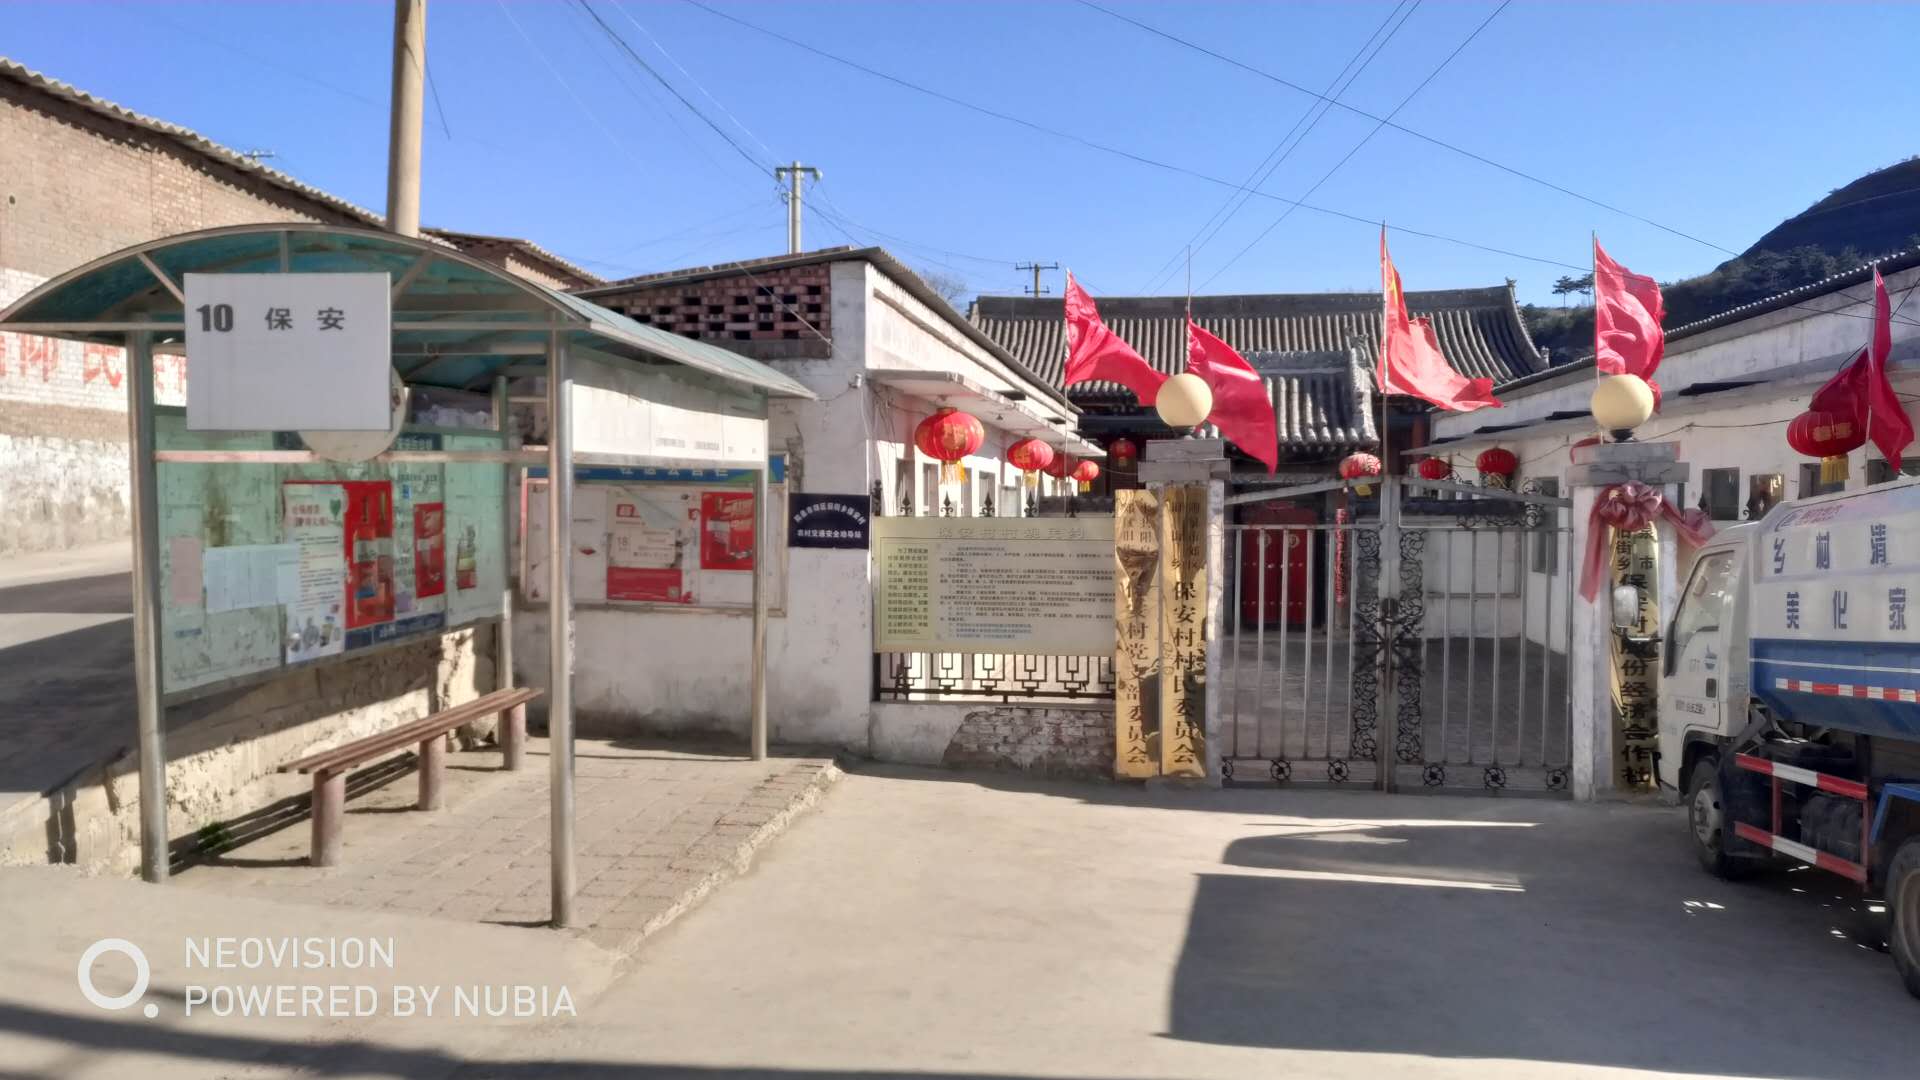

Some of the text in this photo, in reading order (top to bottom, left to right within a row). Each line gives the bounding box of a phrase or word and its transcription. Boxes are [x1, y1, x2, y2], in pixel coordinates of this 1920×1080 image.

[196, 303, 346, 333] 10 保安
[1173, 581, 1197, 764] 保安村村民委员会
